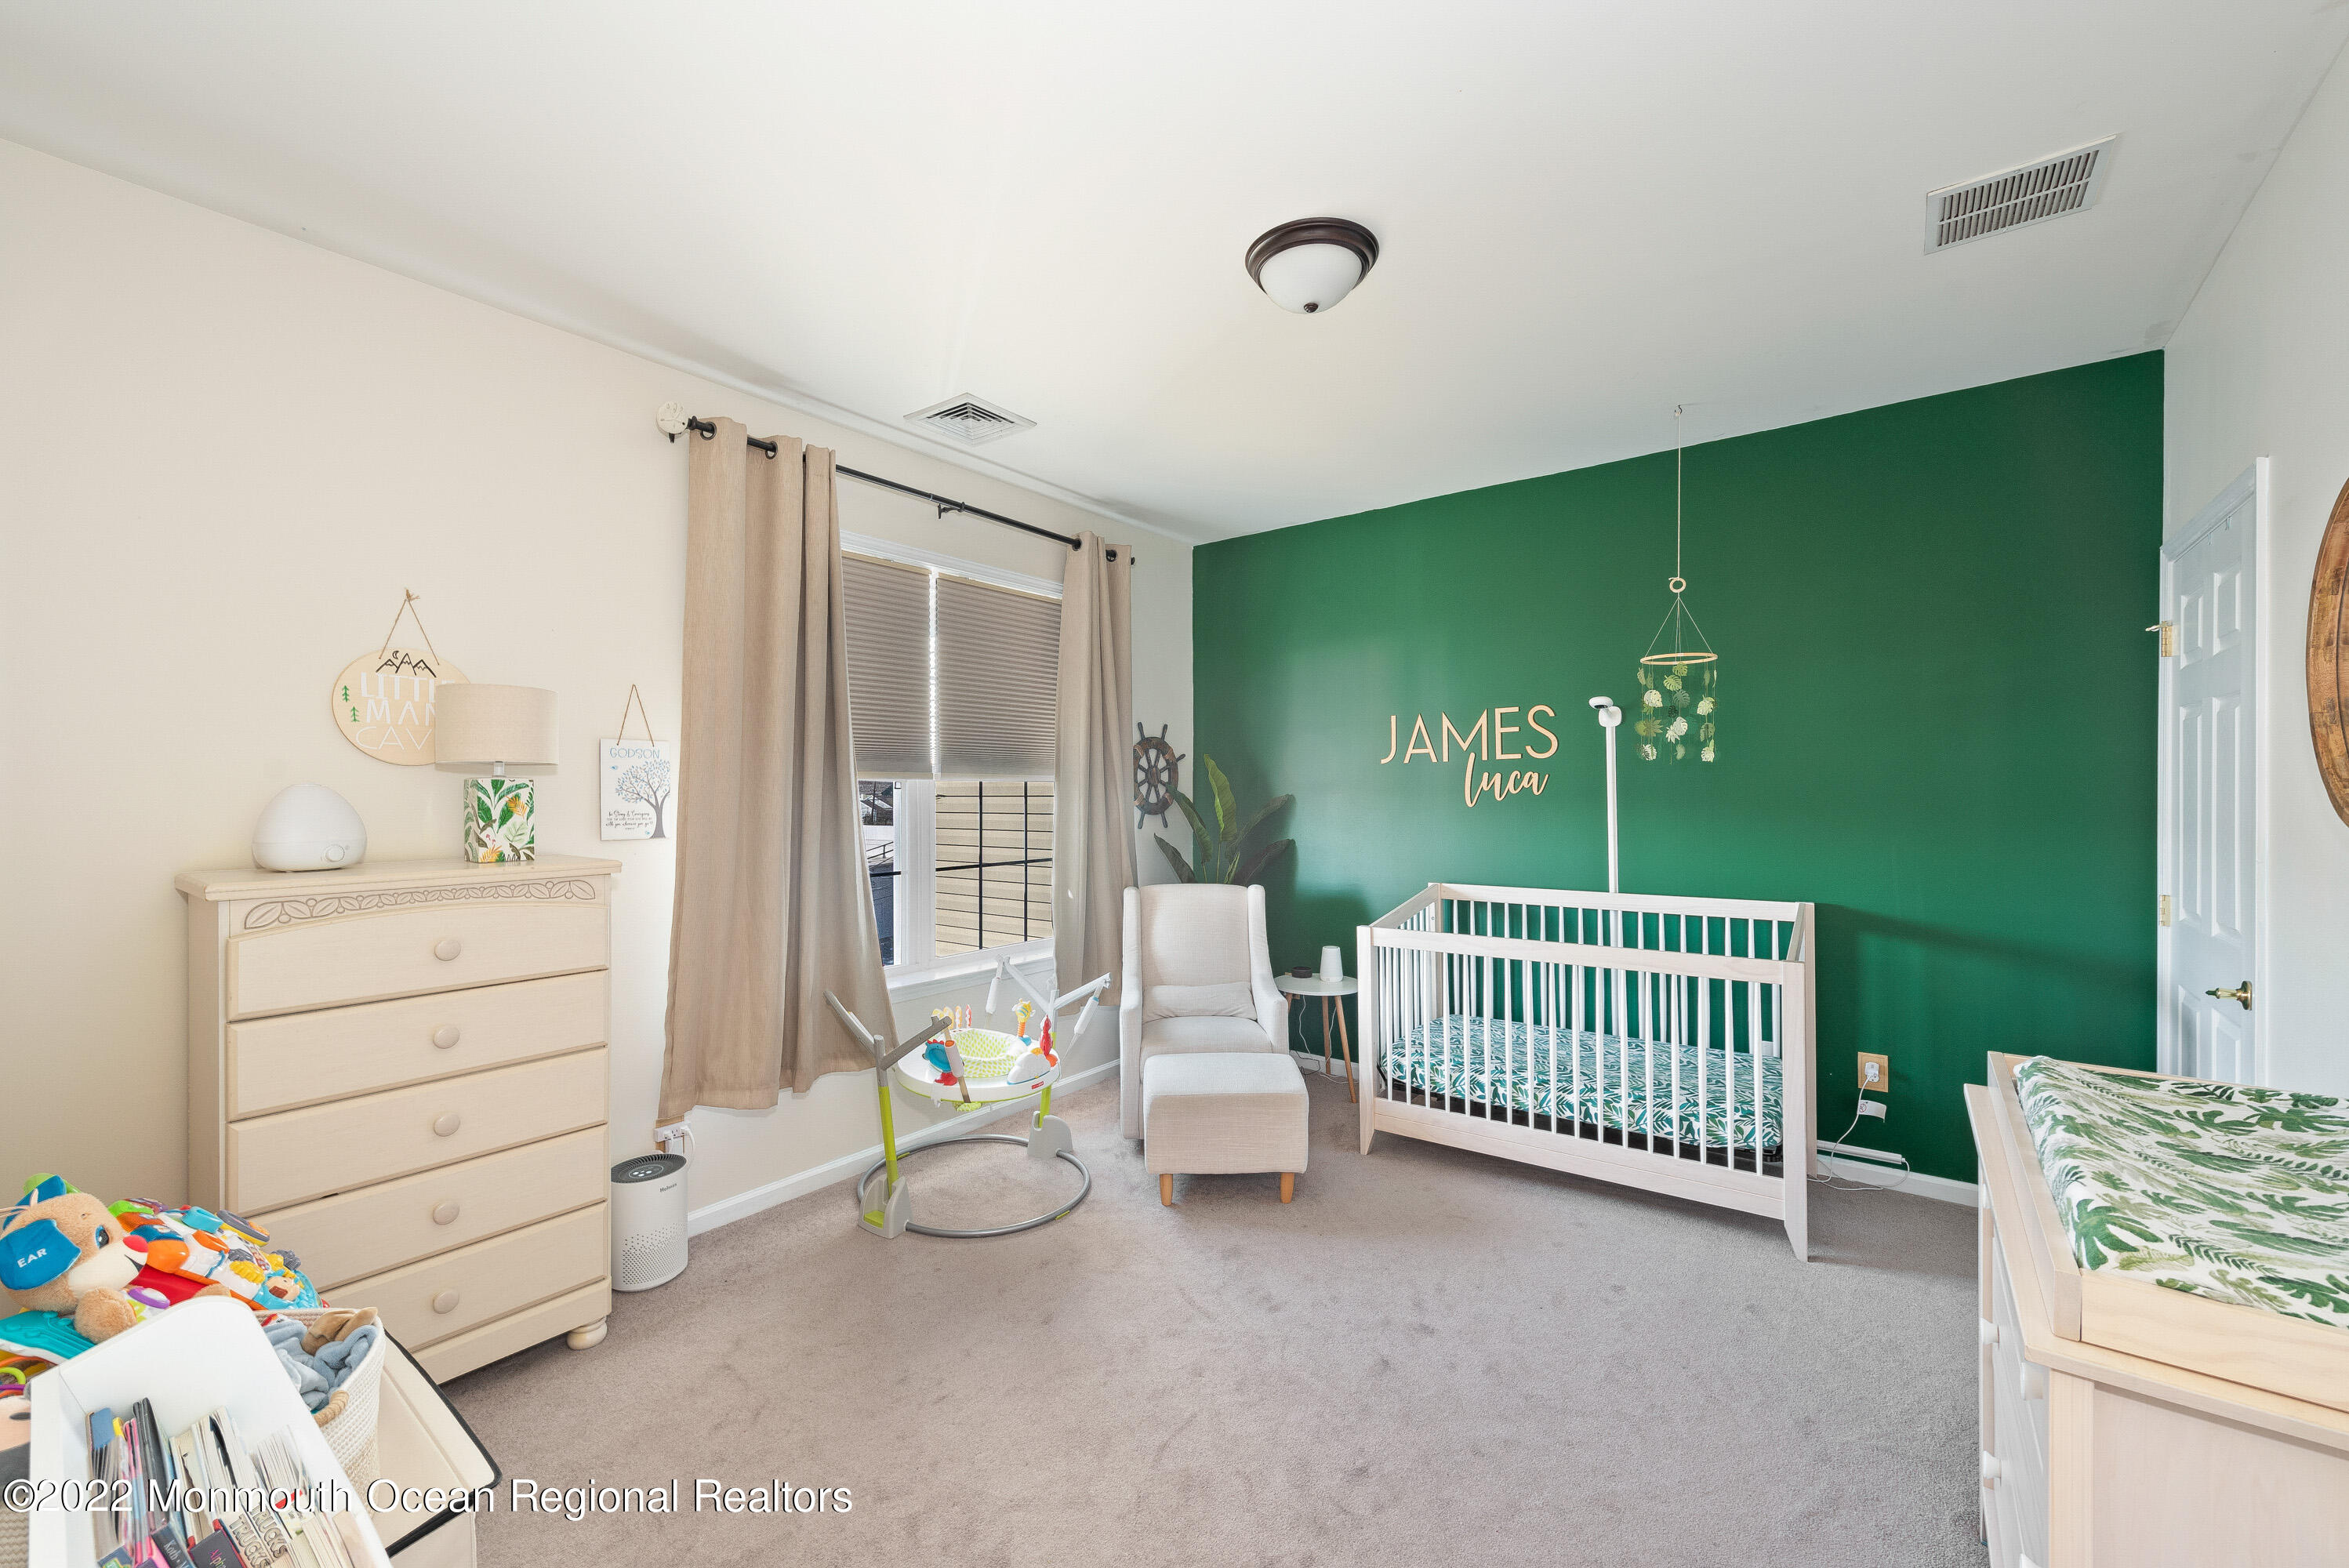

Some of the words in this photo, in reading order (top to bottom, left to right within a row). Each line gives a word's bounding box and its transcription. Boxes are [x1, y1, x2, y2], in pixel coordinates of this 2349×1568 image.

[361, 672, 456, 703] LITTL
[356, 726, 433, 750] CAV
[1380, 704, 1559, 764] JAMES
[610, 747, 660, 759] GODSON
[17, 1248, 47, 1268] EAR
